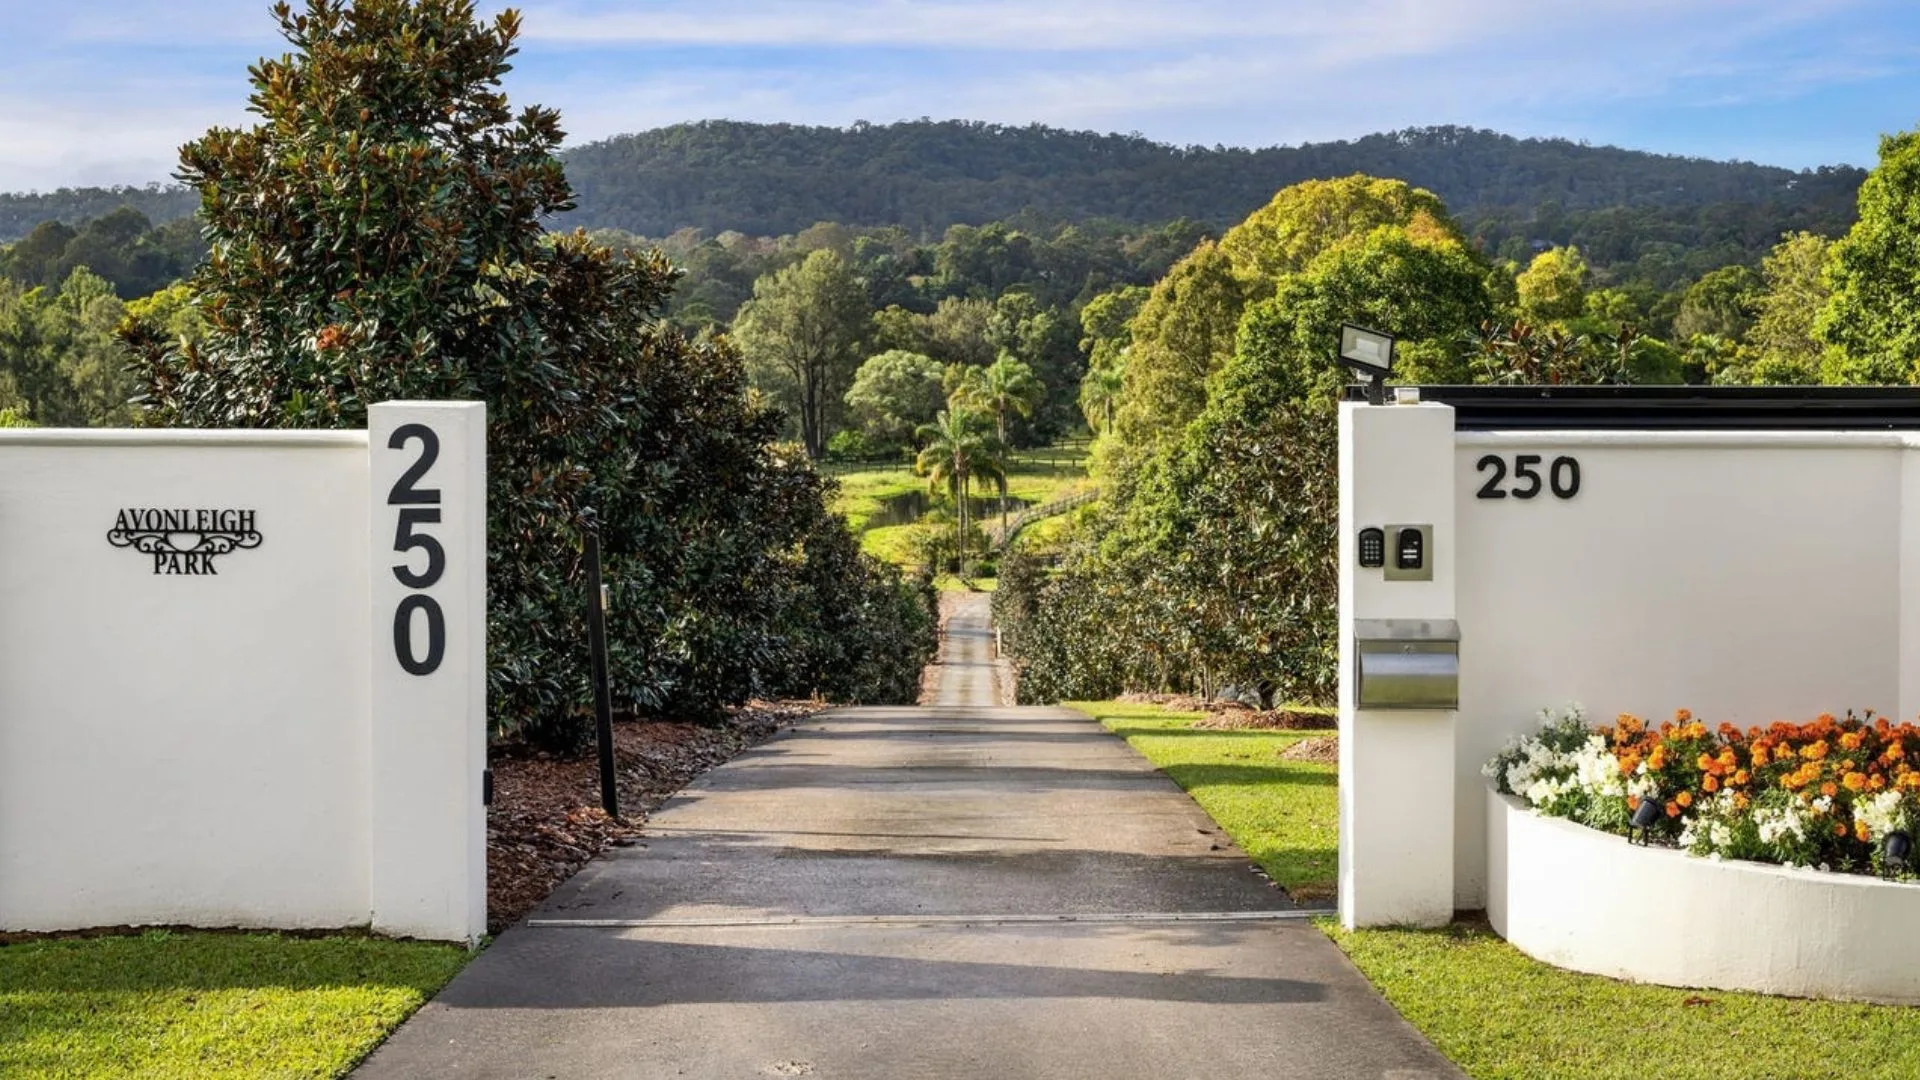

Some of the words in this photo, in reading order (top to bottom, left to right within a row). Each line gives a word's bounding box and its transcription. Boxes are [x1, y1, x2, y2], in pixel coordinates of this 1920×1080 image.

[1475, 454, 1581, 500] 250
[115, 508, 256, 532] AVONLEIGH
[153, 551, 218, 575] PARK
[388, 424, 446, 677] 250
